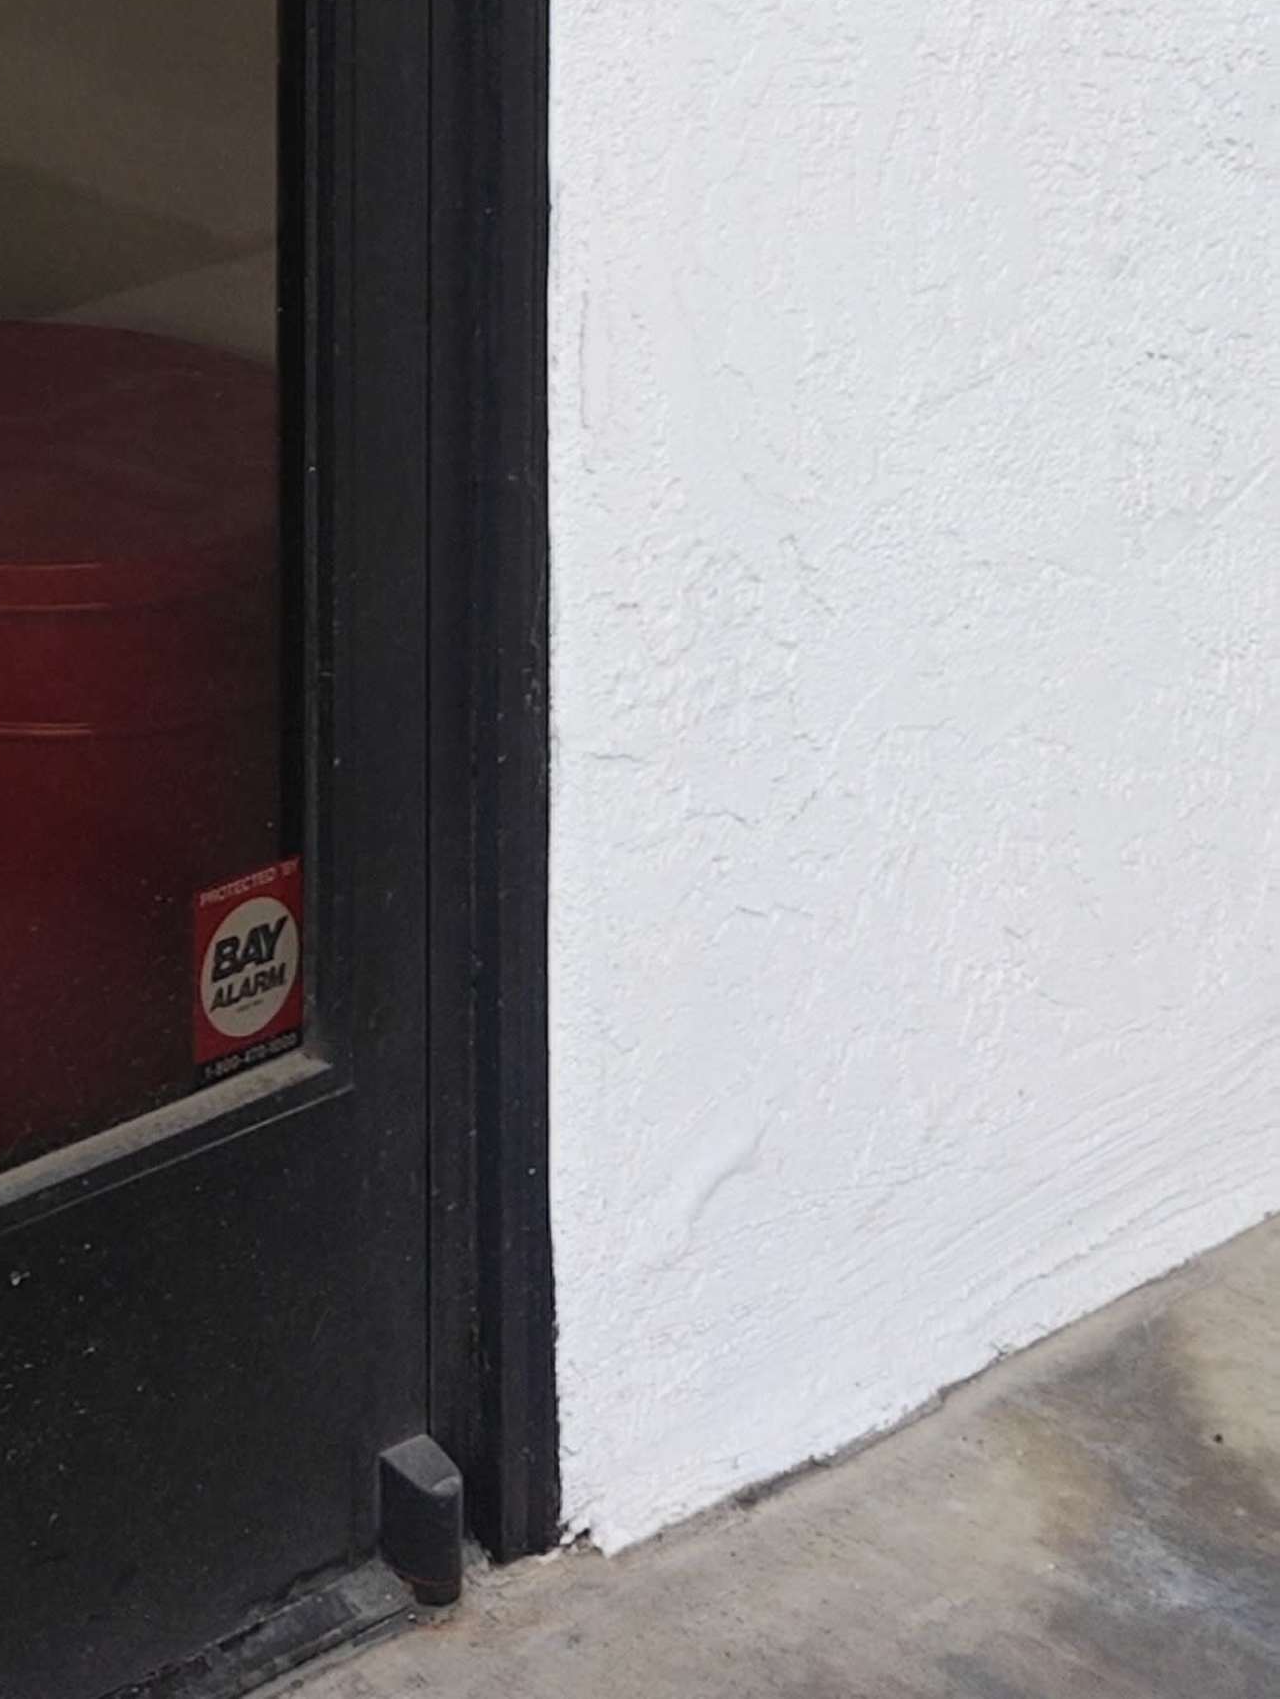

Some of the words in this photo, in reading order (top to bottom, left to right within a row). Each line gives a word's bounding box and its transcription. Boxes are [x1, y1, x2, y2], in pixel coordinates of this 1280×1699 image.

[199, 865, 278, 907] PROTECTED
[211, 915, 289, 984] BAY
[209, 962, 287, 1014] ALARM
